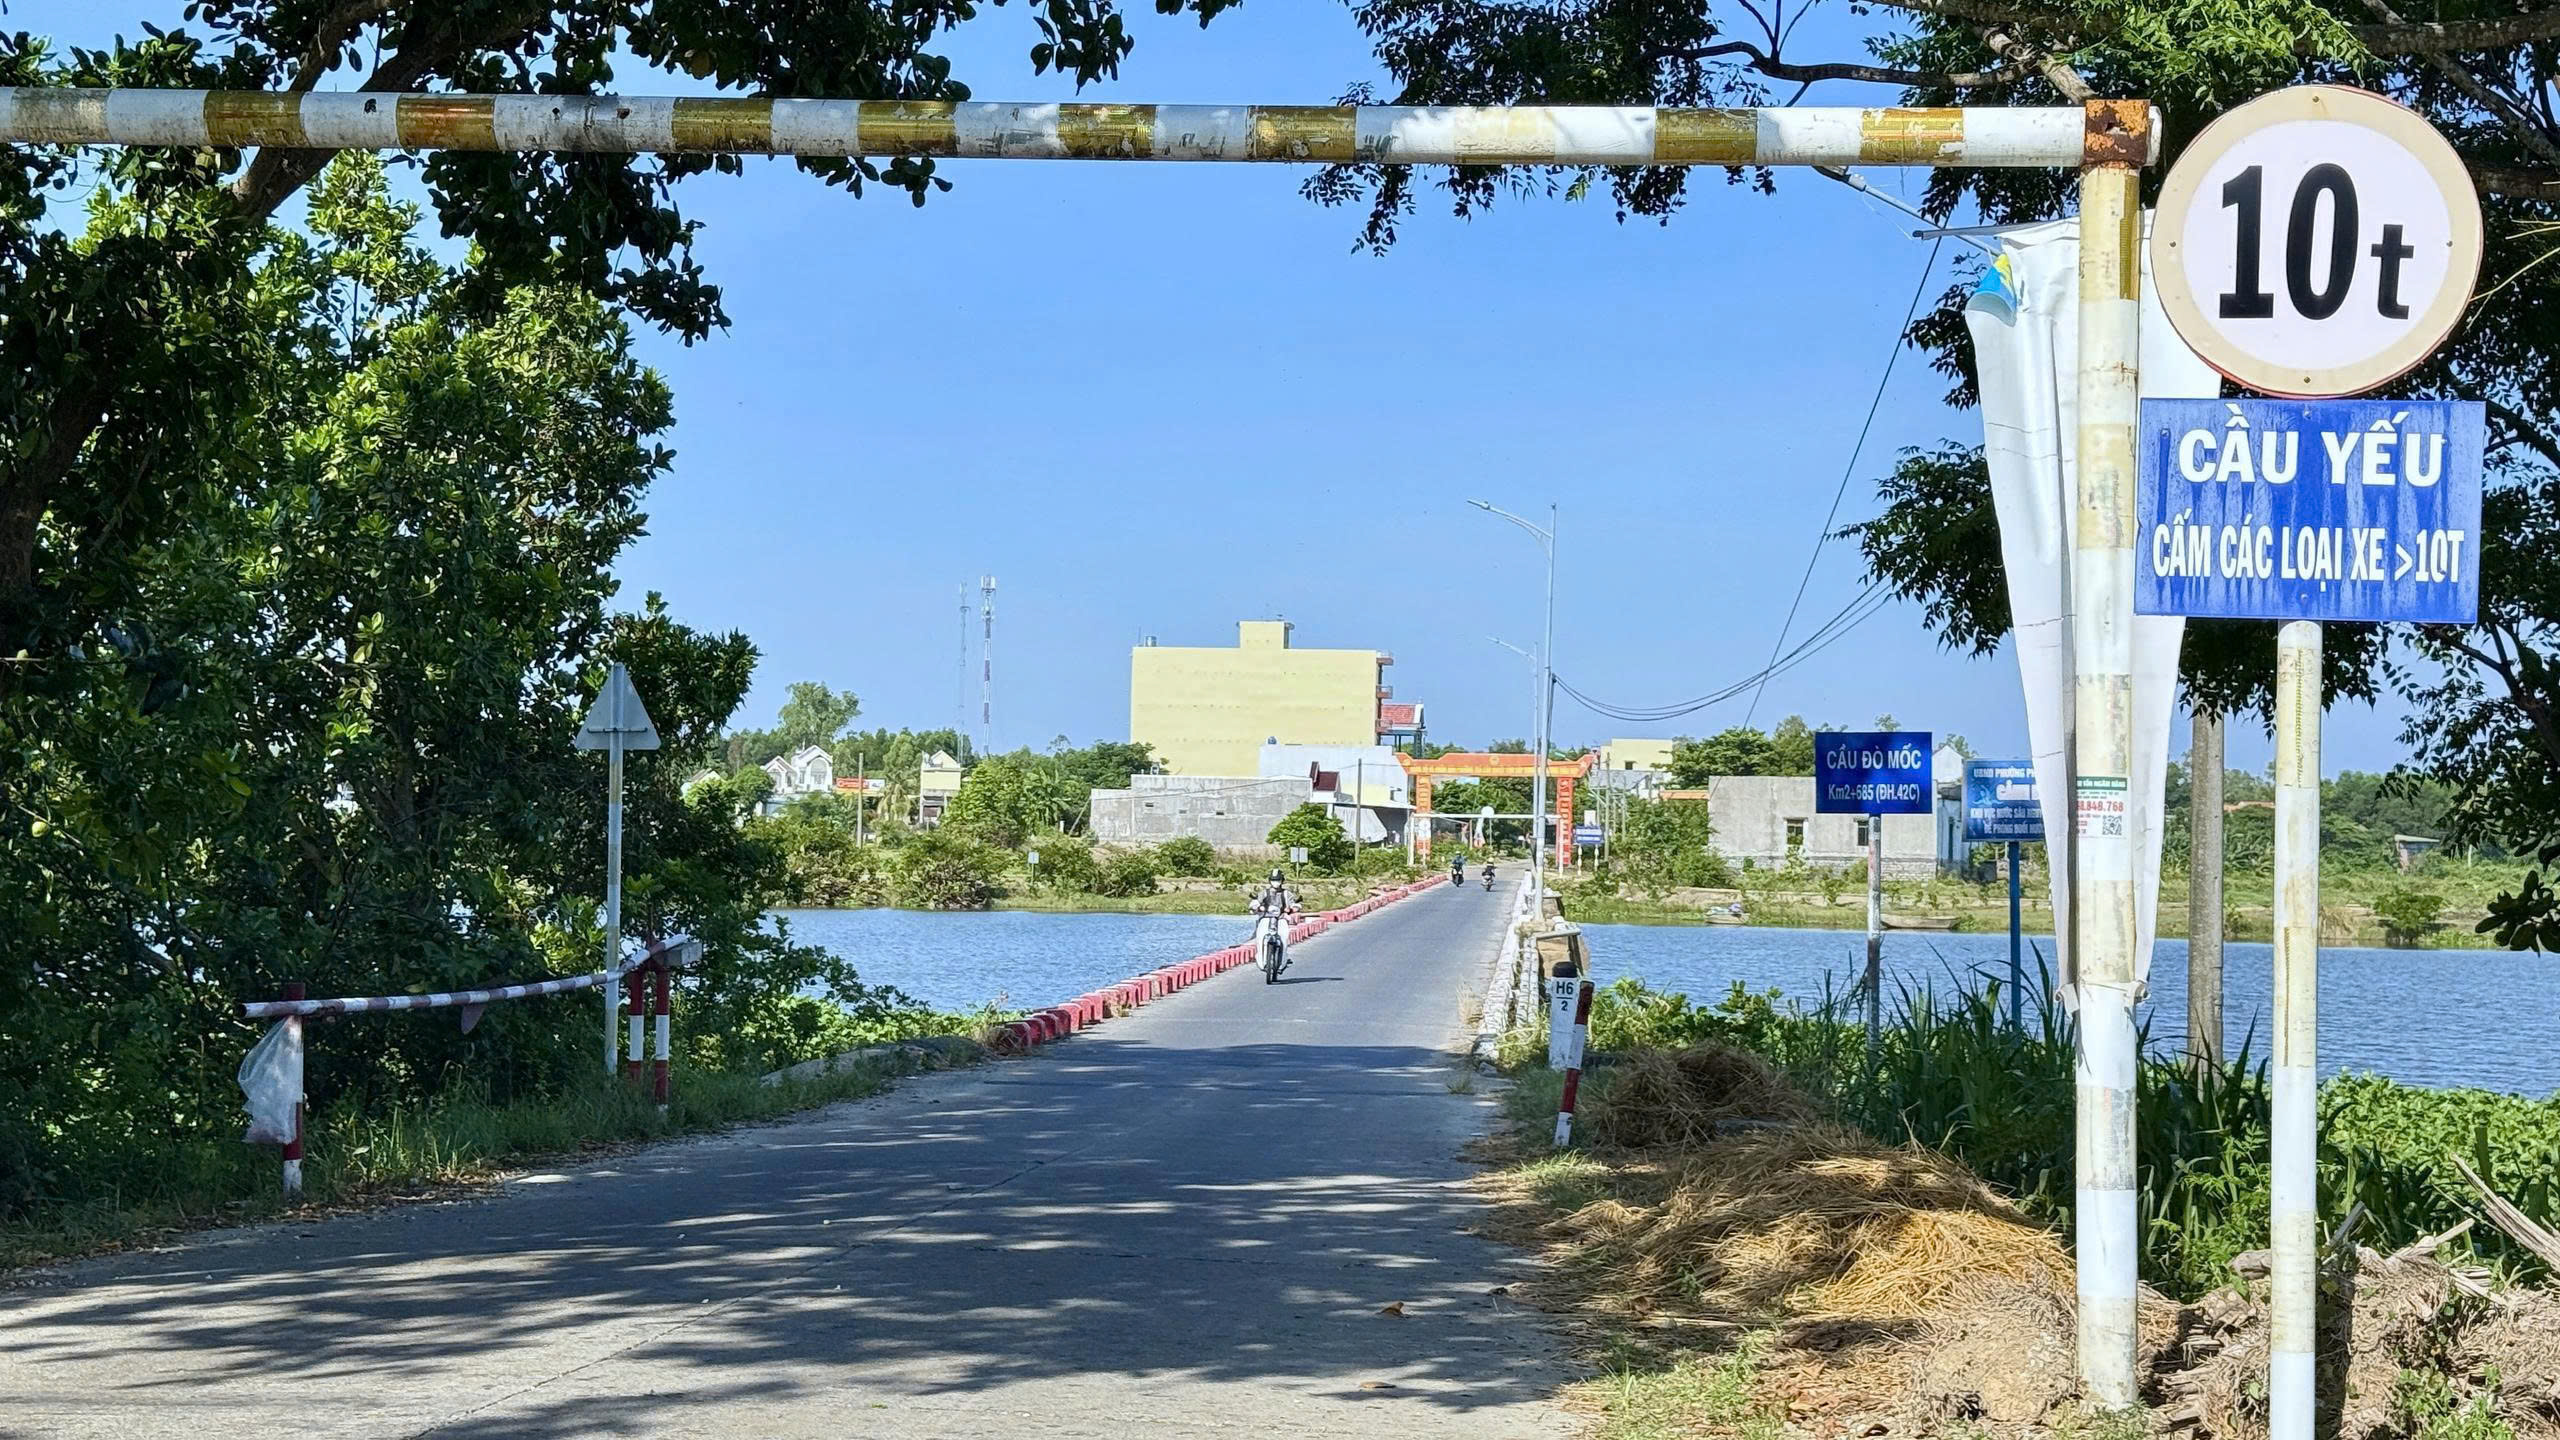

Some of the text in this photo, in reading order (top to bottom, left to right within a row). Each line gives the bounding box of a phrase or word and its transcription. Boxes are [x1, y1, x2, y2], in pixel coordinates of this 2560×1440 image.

[2177, 403, 2445, 487] CẦU YẾU
[2152, 508, 2211, 578] CẤM
[2219, 514, 2273, 579] CÁC
[2281, 526, 2343, 592] LOẠI
[2350, 528, 2385, 583] XE
[1827, 743, 1922, 770] CẦU ĐÒ MỐC
[1828, 783, 1920, 804] Km2+685 (ĐH.42C)
[1556, 980, 1574, 995] H6
[1561, 1000, 1568, 1011] 2
